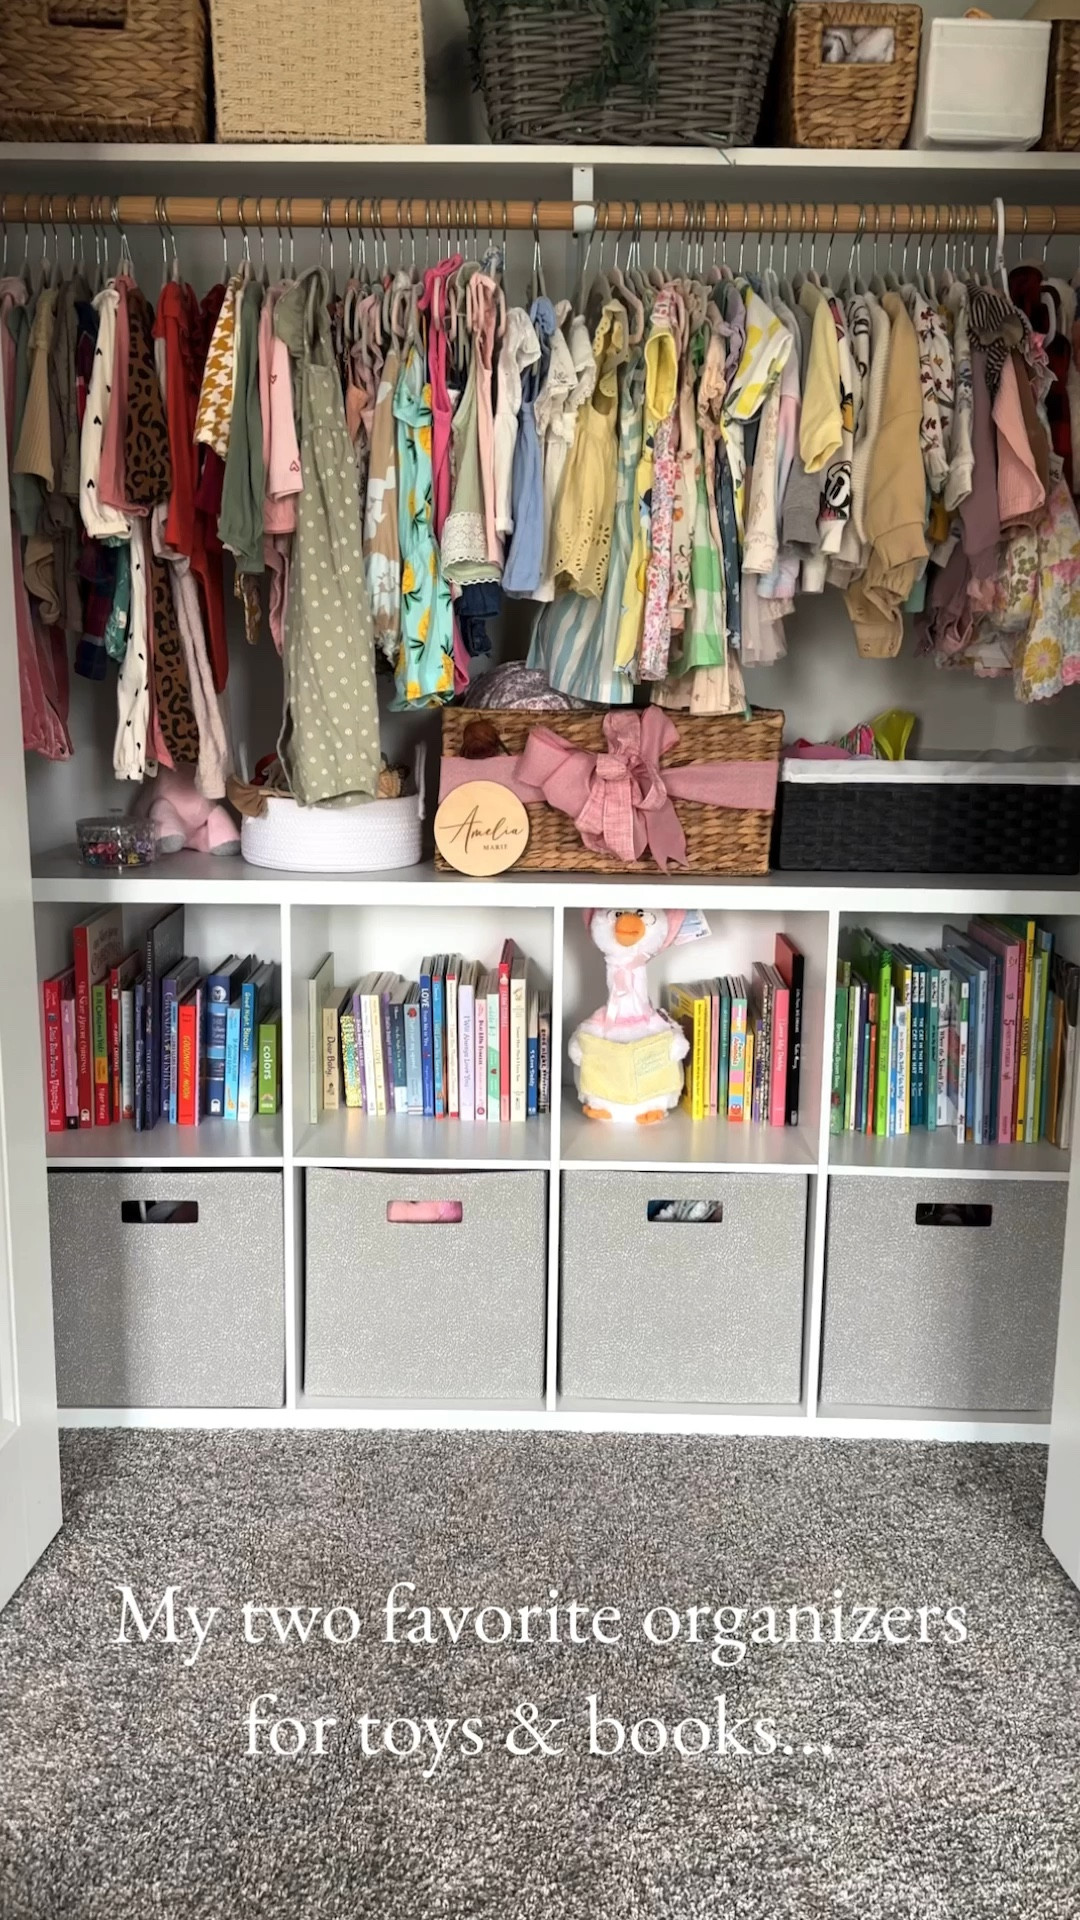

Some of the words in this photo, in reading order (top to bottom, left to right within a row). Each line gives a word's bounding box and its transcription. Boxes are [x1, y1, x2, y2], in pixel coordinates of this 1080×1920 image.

[439, 805, 523, 854] Amelia
[422, 988, 430, 1008] LOVE
[243, 1028, 251, 1051] Biscuit
[327, 1036, 336, 1055] Dear
[183, 1035, 192, 1077] GOODNIGHT
[263, 1045, 273, 1080] colors
[183, 1078, 191, 1100] MOON
